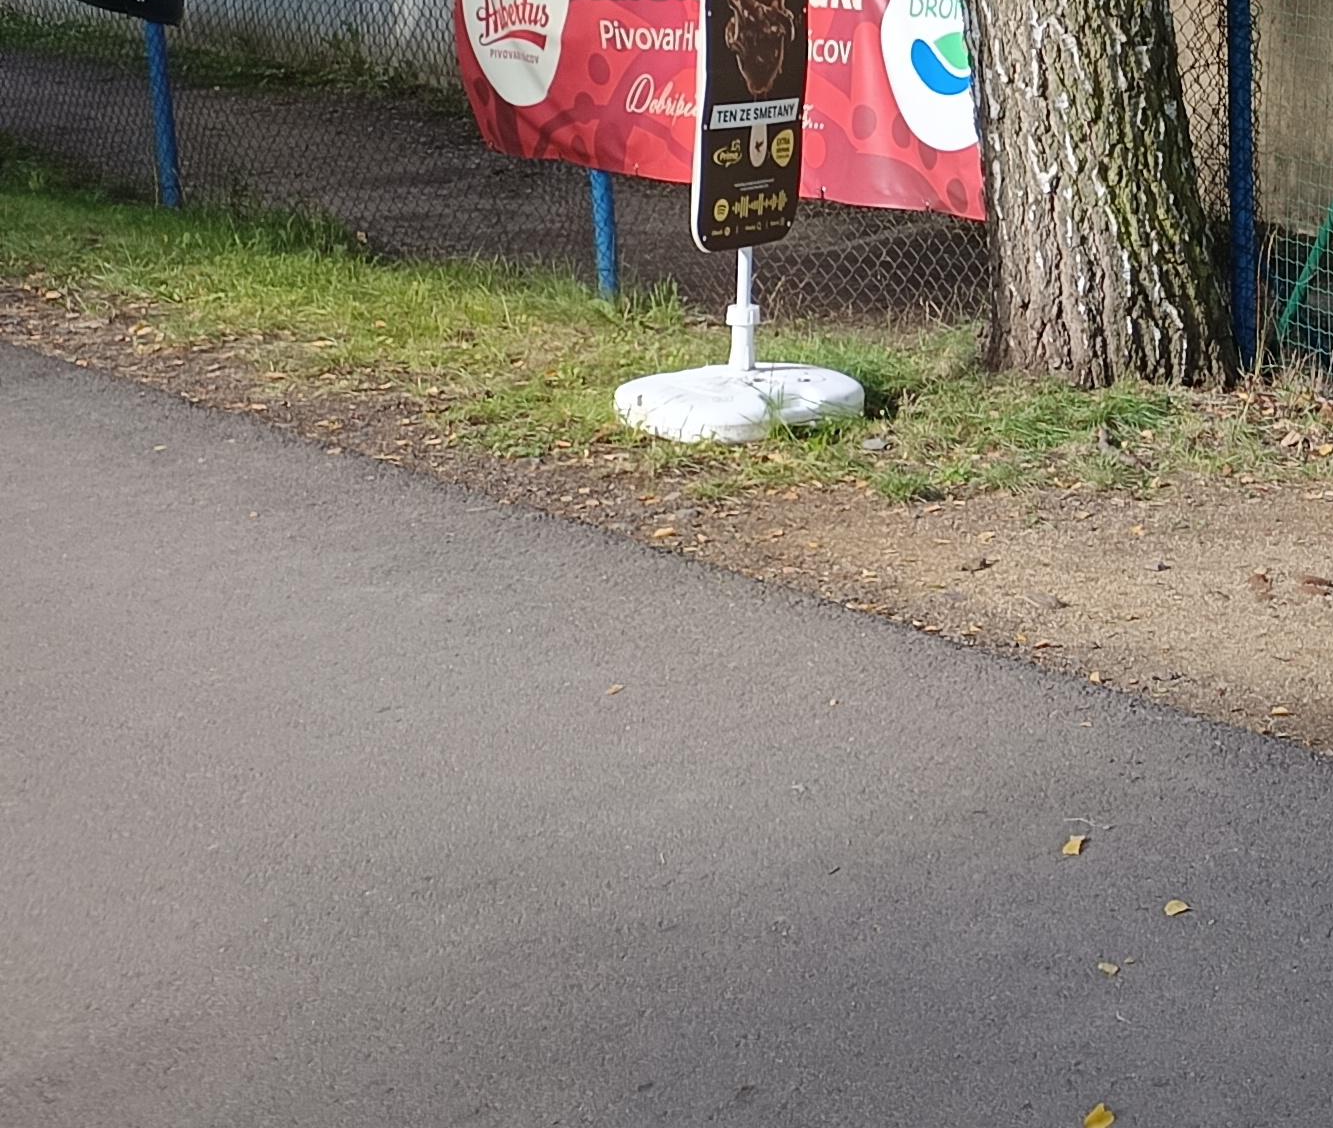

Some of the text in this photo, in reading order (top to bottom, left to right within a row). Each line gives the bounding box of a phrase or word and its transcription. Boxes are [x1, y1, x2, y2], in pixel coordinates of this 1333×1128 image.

[717, 109, 738, 123] TEN
[739, 107, 752, 121] ZE
[753, 103, 796, 121] SMETANY
